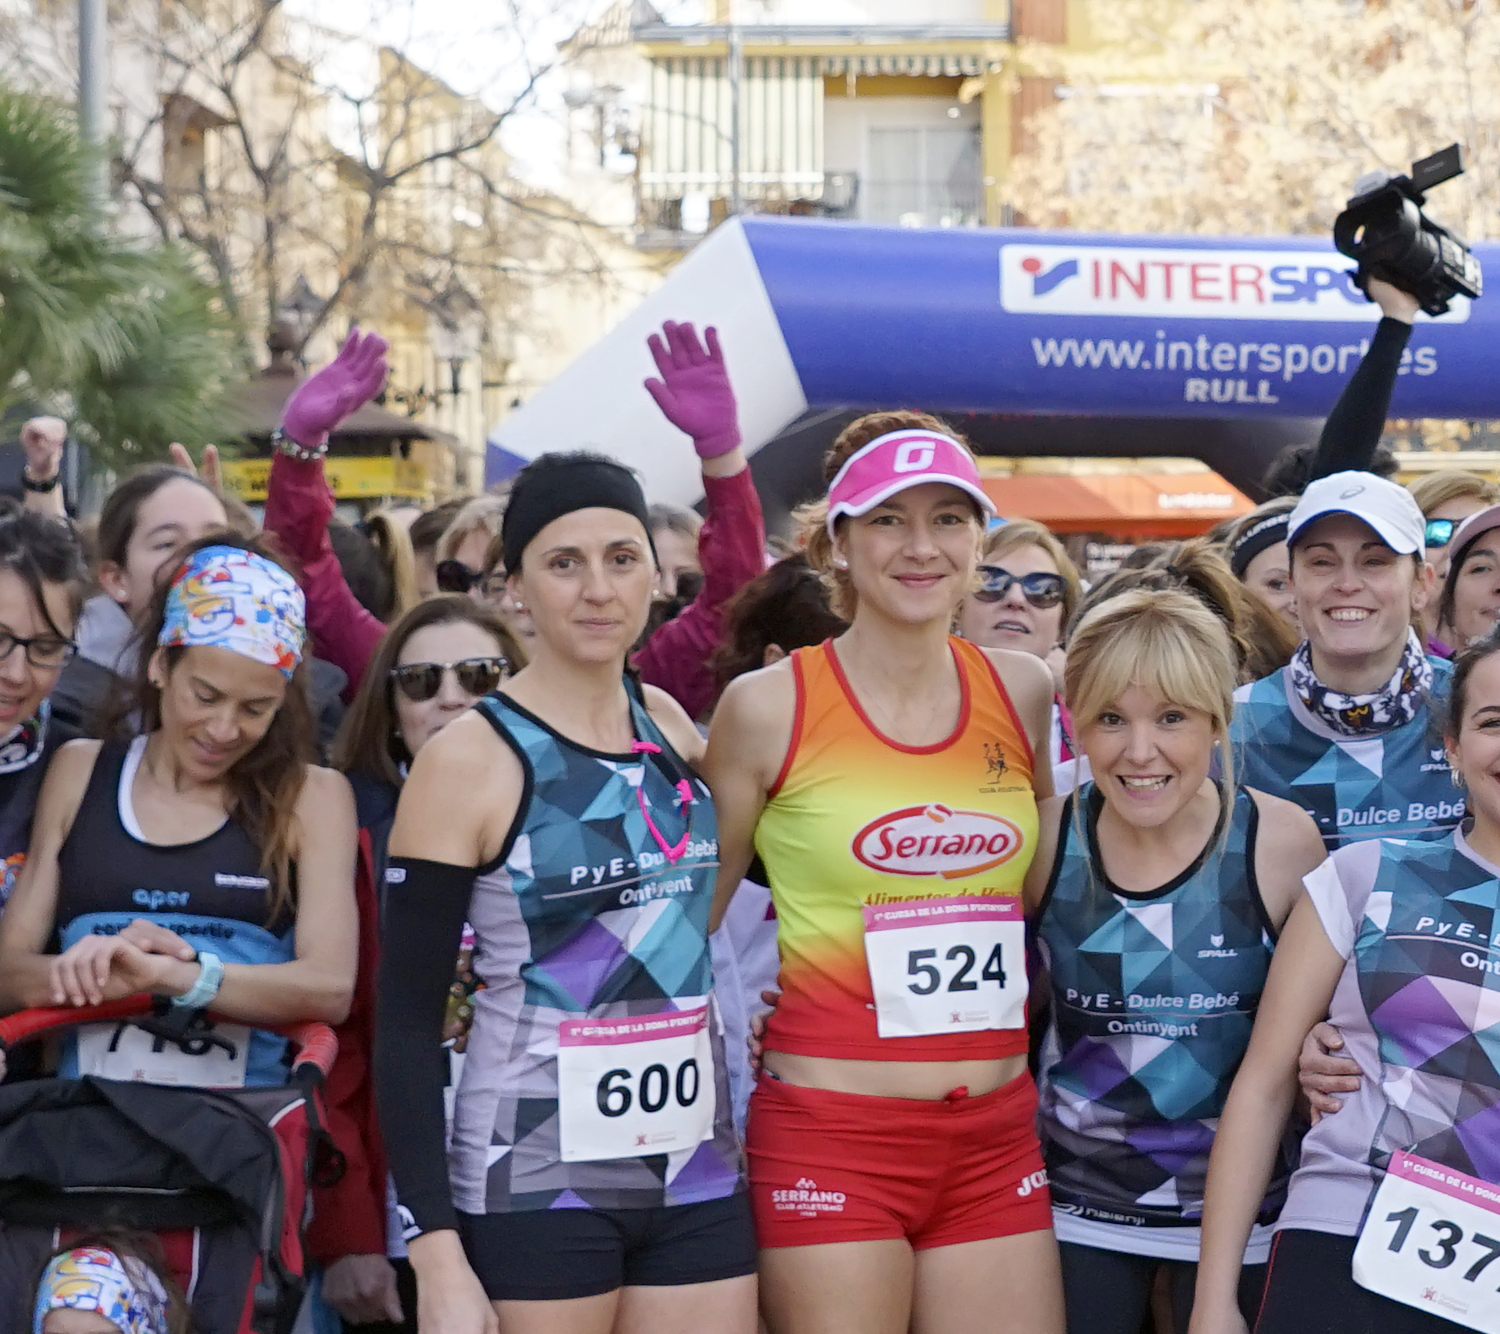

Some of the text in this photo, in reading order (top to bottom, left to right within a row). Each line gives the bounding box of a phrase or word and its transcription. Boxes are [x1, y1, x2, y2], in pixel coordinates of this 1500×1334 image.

[1031, 332, 1438, 382] www.intersportes
[1184, 378, 1279, 404] RULL
[1335, 806, 1401, 827] Dulce
[1406, 798, 1467, 821] Bebé
[871, 826, 1010, 861] Serrano
[1196, 948, 1239, 959] SPALL
[907, 943, 1007, 996] 524
[1127, 993, 1185, 1009] Dulce
[1187, 990, 1240, 1009] Bebé
[1107, 1019, 1199, 1037] Ontinyent
[596, 1057, 700, 1118] 600
[1413, 1164, 1445, 1182] CURSA
[1446, 1176, 1460, 1189] DE
[1460, 1181, 1474, 1194] LA
[771, 1189, 847, 1204] SERRANO
